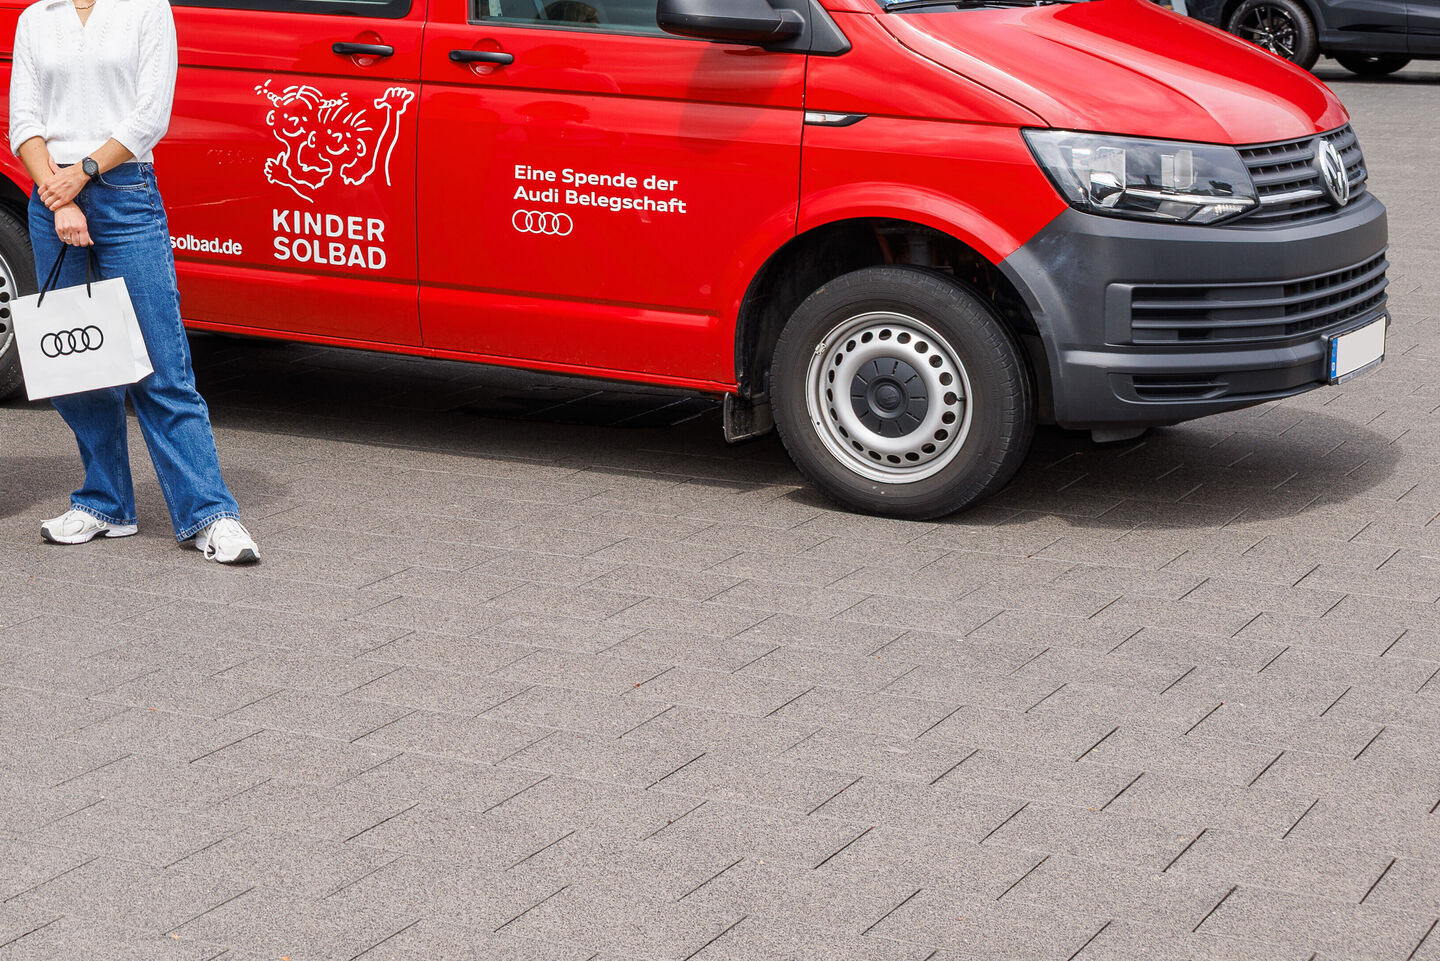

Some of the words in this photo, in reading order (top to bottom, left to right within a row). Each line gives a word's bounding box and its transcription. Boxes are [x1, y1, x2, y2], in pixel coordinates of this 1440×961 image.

[514, 164, 557, 182] Eine
[561, 168, 638, 188] Spende
[642, 175, 678, 191] der
[513, 185, 559, 203] Audi
[565, 189, 687, 214] Belegschaft
[272, 208, 385, 242] KINDER
[273, 236, 387, 270] SOLBAD
